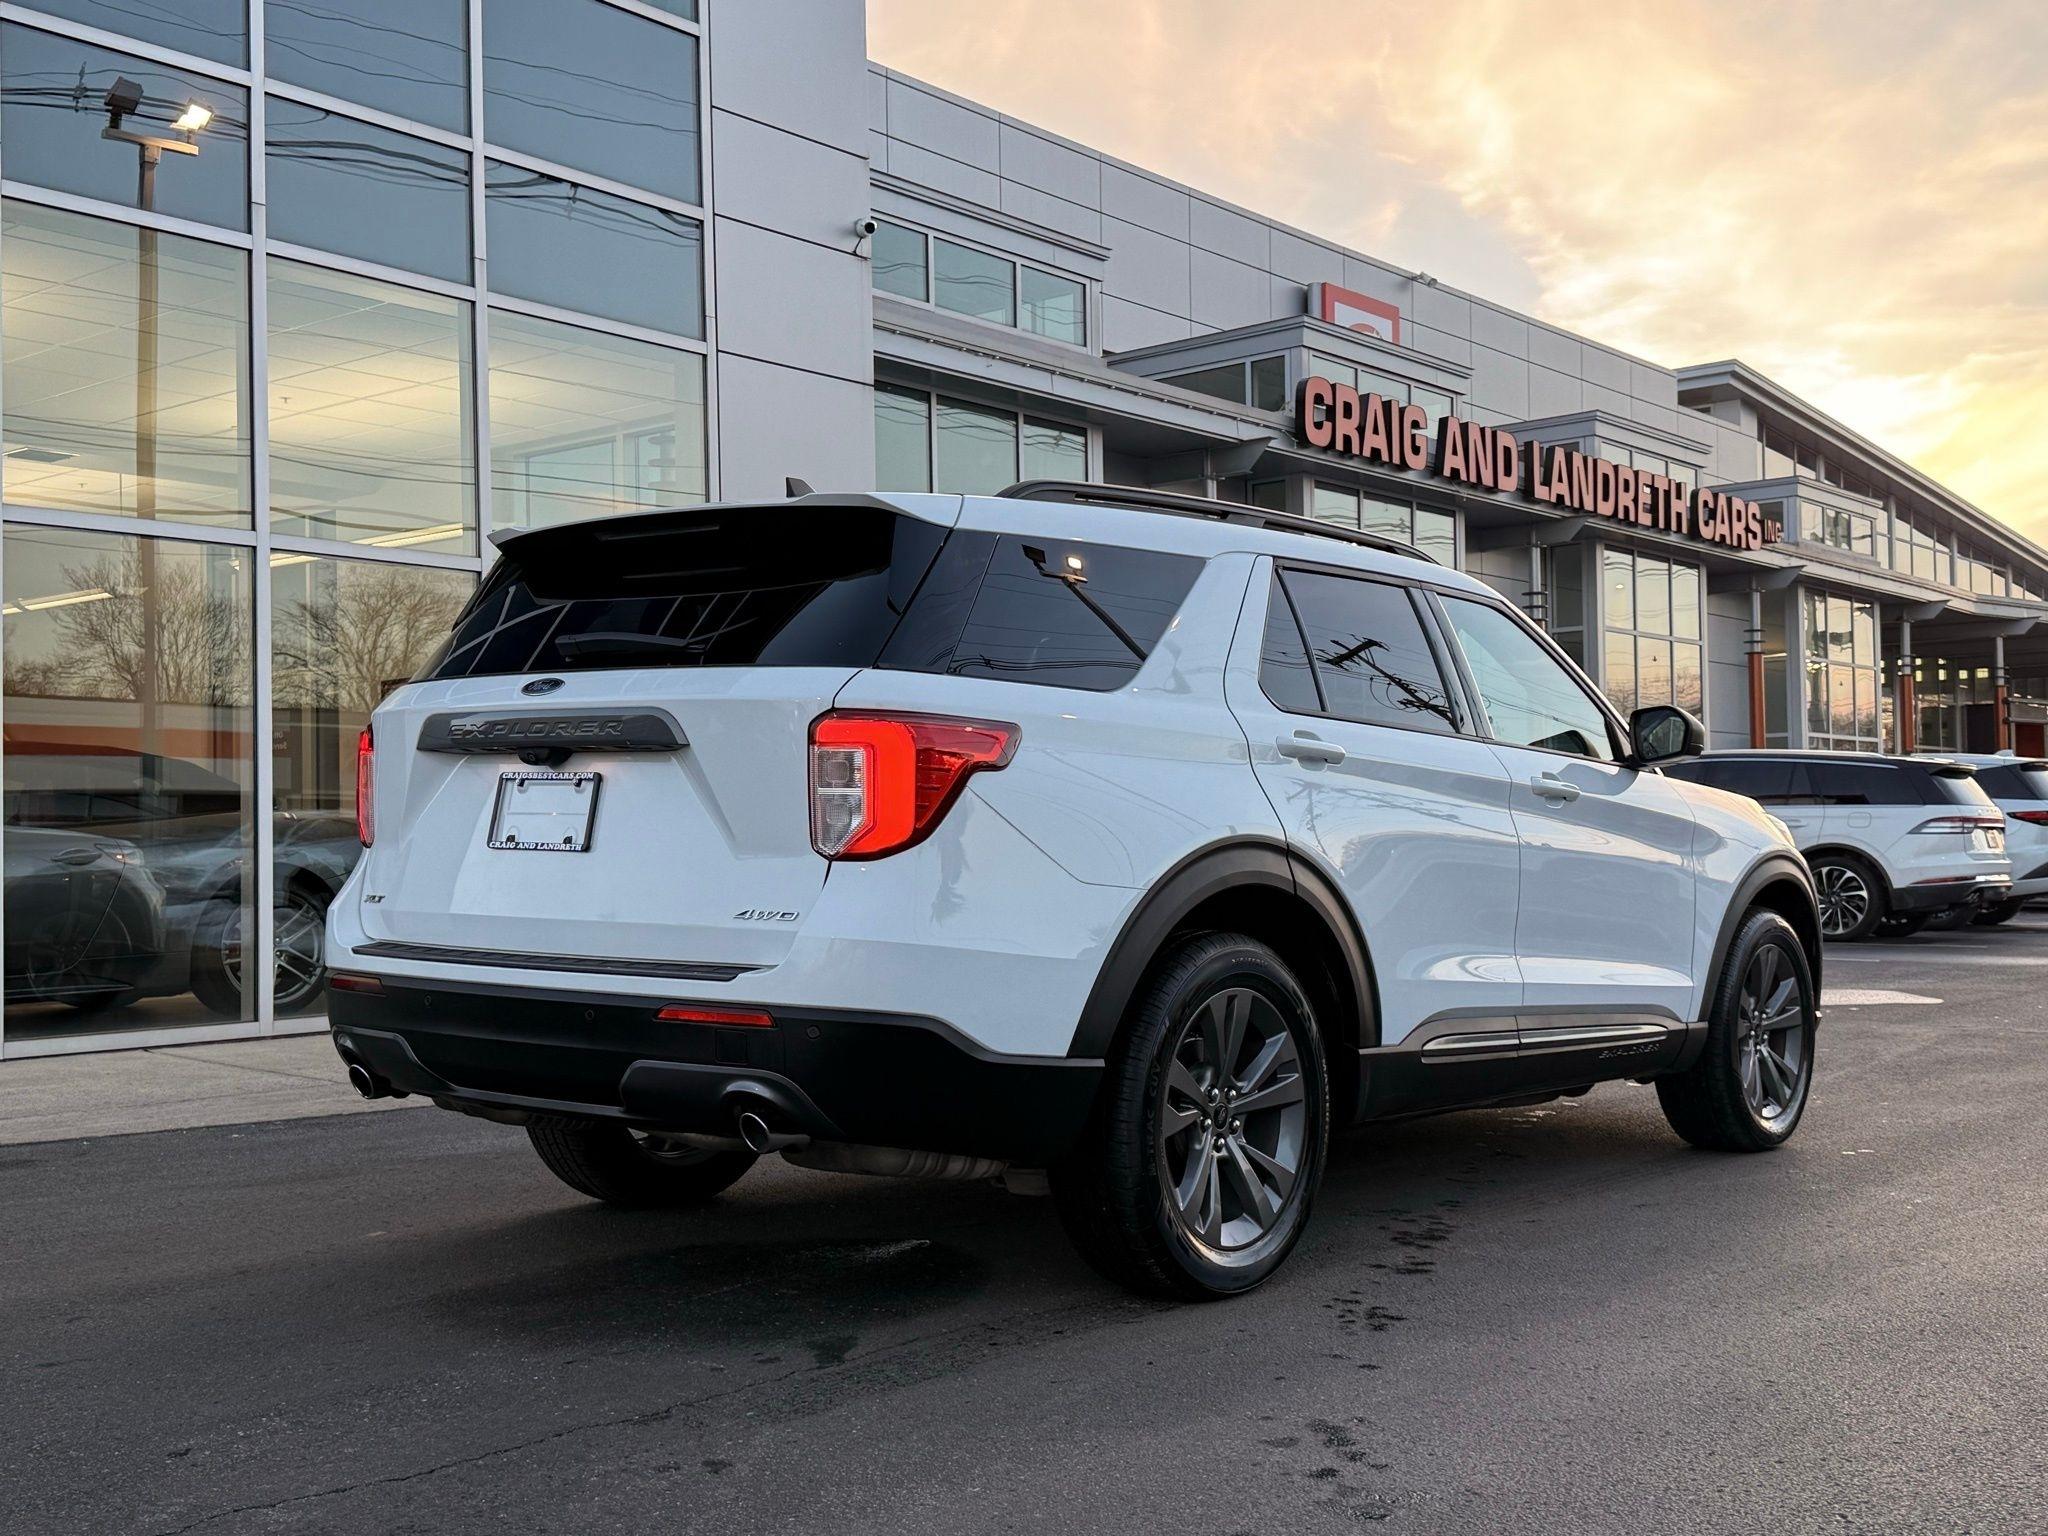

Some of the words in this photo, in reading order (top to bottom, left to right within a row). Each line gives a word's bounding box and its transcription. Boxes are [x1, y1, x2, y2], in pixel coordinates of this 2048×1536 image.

[1300, 375, 1428, 470] CRAIG
[1441, 416, 1518, 492] AND
[1531, 440, 1688, 532] LANDRETH
[1698, 487, 1762, 551] CARS
[447, 720, 624, 739] EXPLORER
[502, 772, 594, 780] CRAIGSBESTCARS.COM
[489, 841, 516, 849] CRAIG
[517, 842, 536, 850] AND
[537, 843, 582, 851] LANDRETH
[733, 909, 800, 921] 4WD
